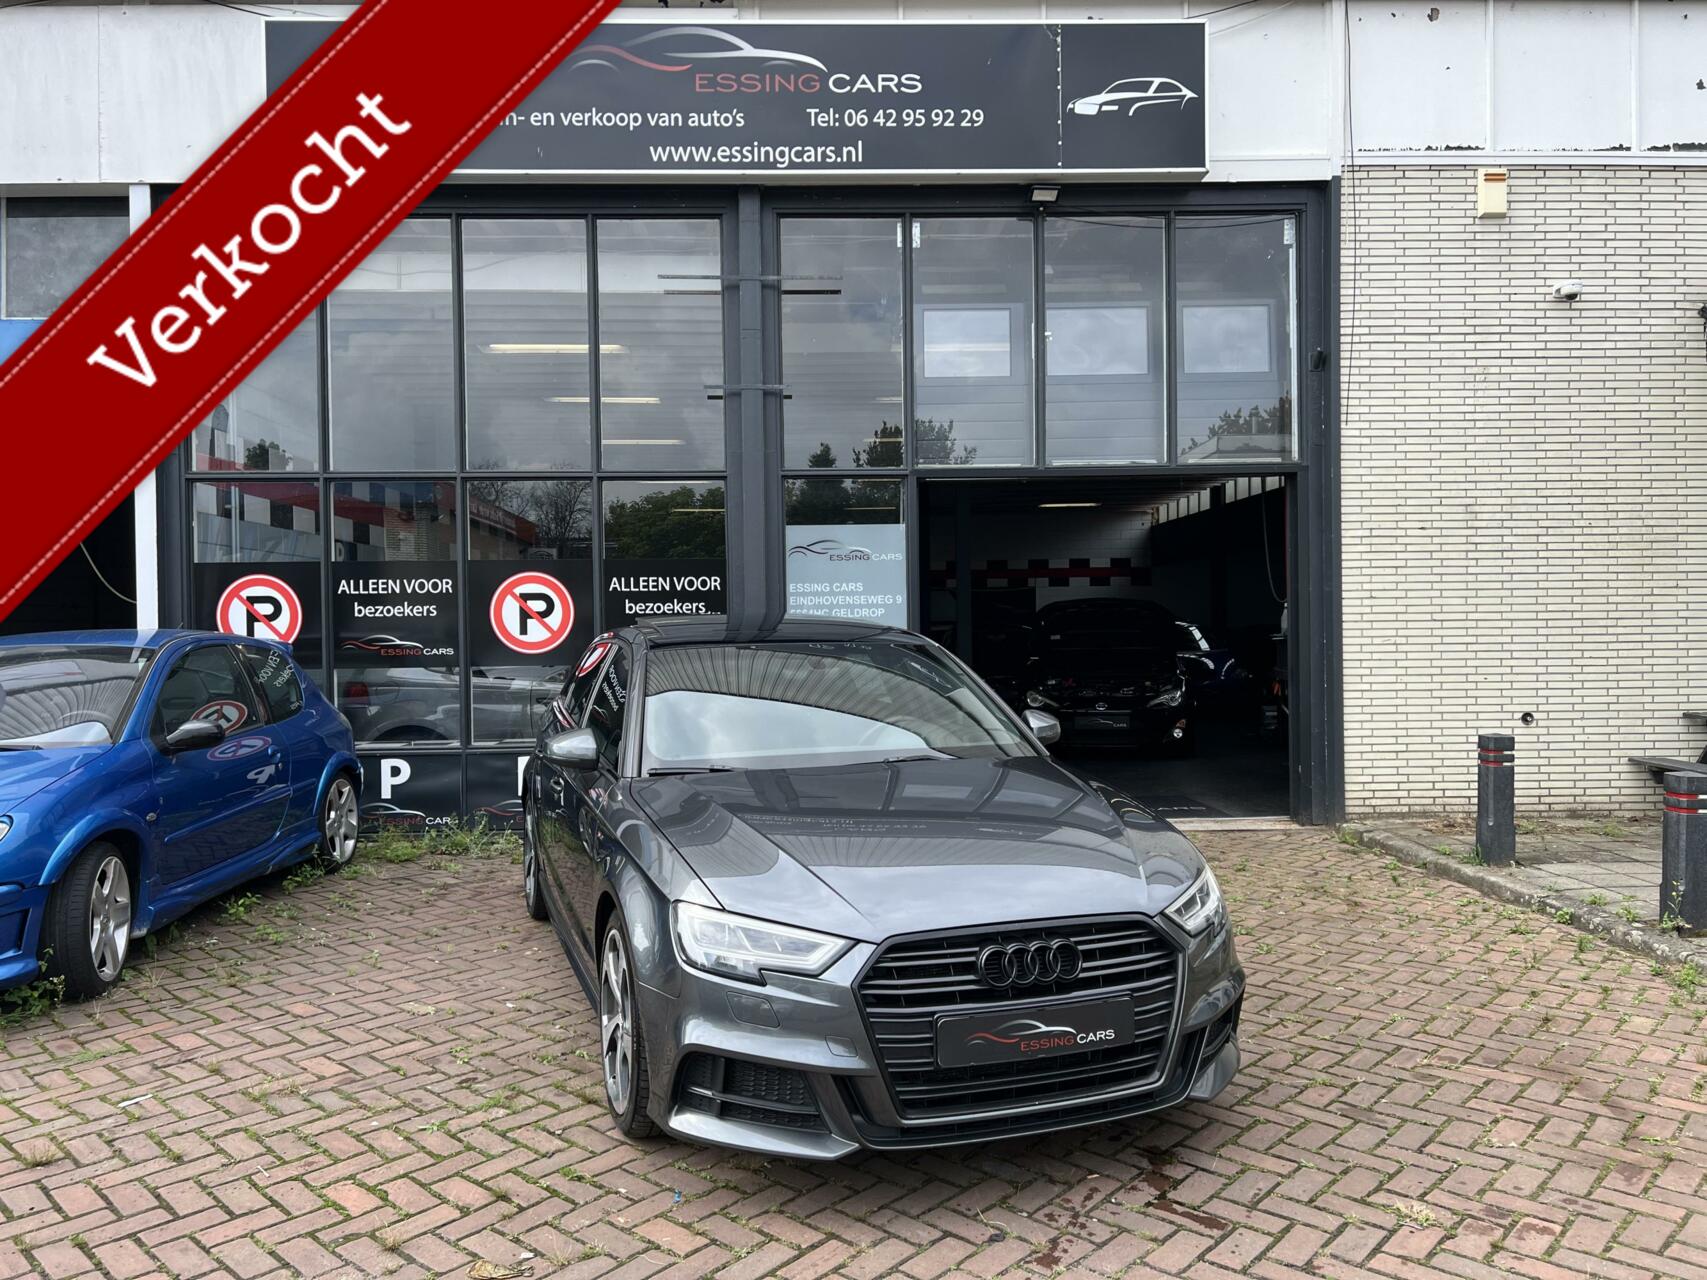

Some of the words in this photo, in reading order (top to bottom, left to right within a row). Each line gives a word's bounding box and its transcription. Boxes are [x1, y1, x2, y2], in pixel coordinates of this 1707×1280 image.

[695, 73, 820, 93] ESSING
[828, 73, 923, 93] CARS
[530, 111, 555, 126] en
[560, 107, 642, 131] verkoop
[647, 111, 683, 127] van
[688, 108, 745, 127] auto's
[806, 108, 840, 127] Tel:
[844, 109, 868, 127] 06
[873, 109, 897, 127] 42
[902, 109, 926, 127] 95
[931, 109, 955, 127] 92
[960, 109, 984, 127] 29
[649, 141, 863, 168] www.essingcars.nl
[871, 553, 903, 561] CARS
[337, 579, 400, 594] ALLEEN
[403, 579, 453, 594] VOOR
[608, 577, 670, 592] ALLEEN
[673, 576, 721, 591] VOOR
[789, 583, 830, 593] ESSING
[832, 582, 864, 592] CARS
[625, 599, 706, 614] bezoekers
[789, 595, 893, 606] EINDHOVENSEWEG
[895, 595, 902, 604] 9
[354, 602, 438, 617] bezoekers
[832, 608, 886, 618] GELDROP
[380, 648, 422, 656] ESSING
[380, 758, 412, 800] P
[1020, 1035, 1075, 1052] ESSING
[1076, 1029, 1116, 1044] CARS
